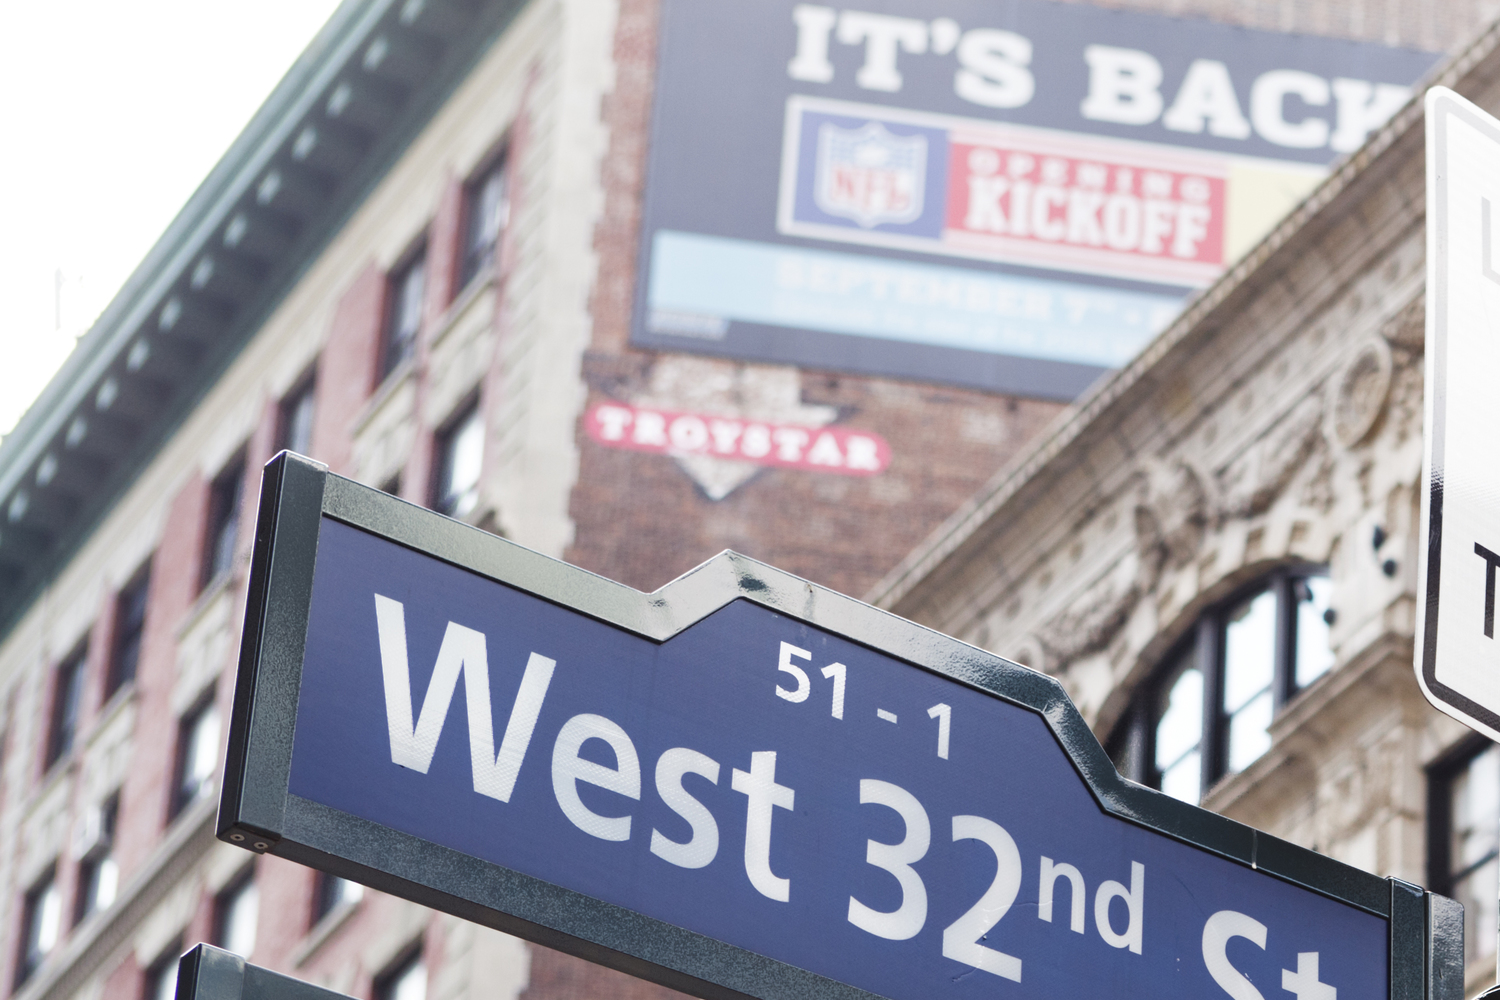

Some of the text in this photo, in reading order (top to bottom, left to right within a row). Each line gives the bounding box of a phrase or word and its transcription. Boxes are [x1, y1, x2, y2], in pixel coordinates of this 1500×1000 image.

[787, 3, 1035, 109] IT'S
[964, 173, 1211, 259] KICKOFF
[967, 146, 1210, 201] OPENING
[774, 252, 1053, 324] SEPTEMBER
[596, 404, 881, 472] TROYSTAR
[775, 640, 846, 721] 51
[926, 702, 952, 761] 1
[373, 592, 796, 903] West
